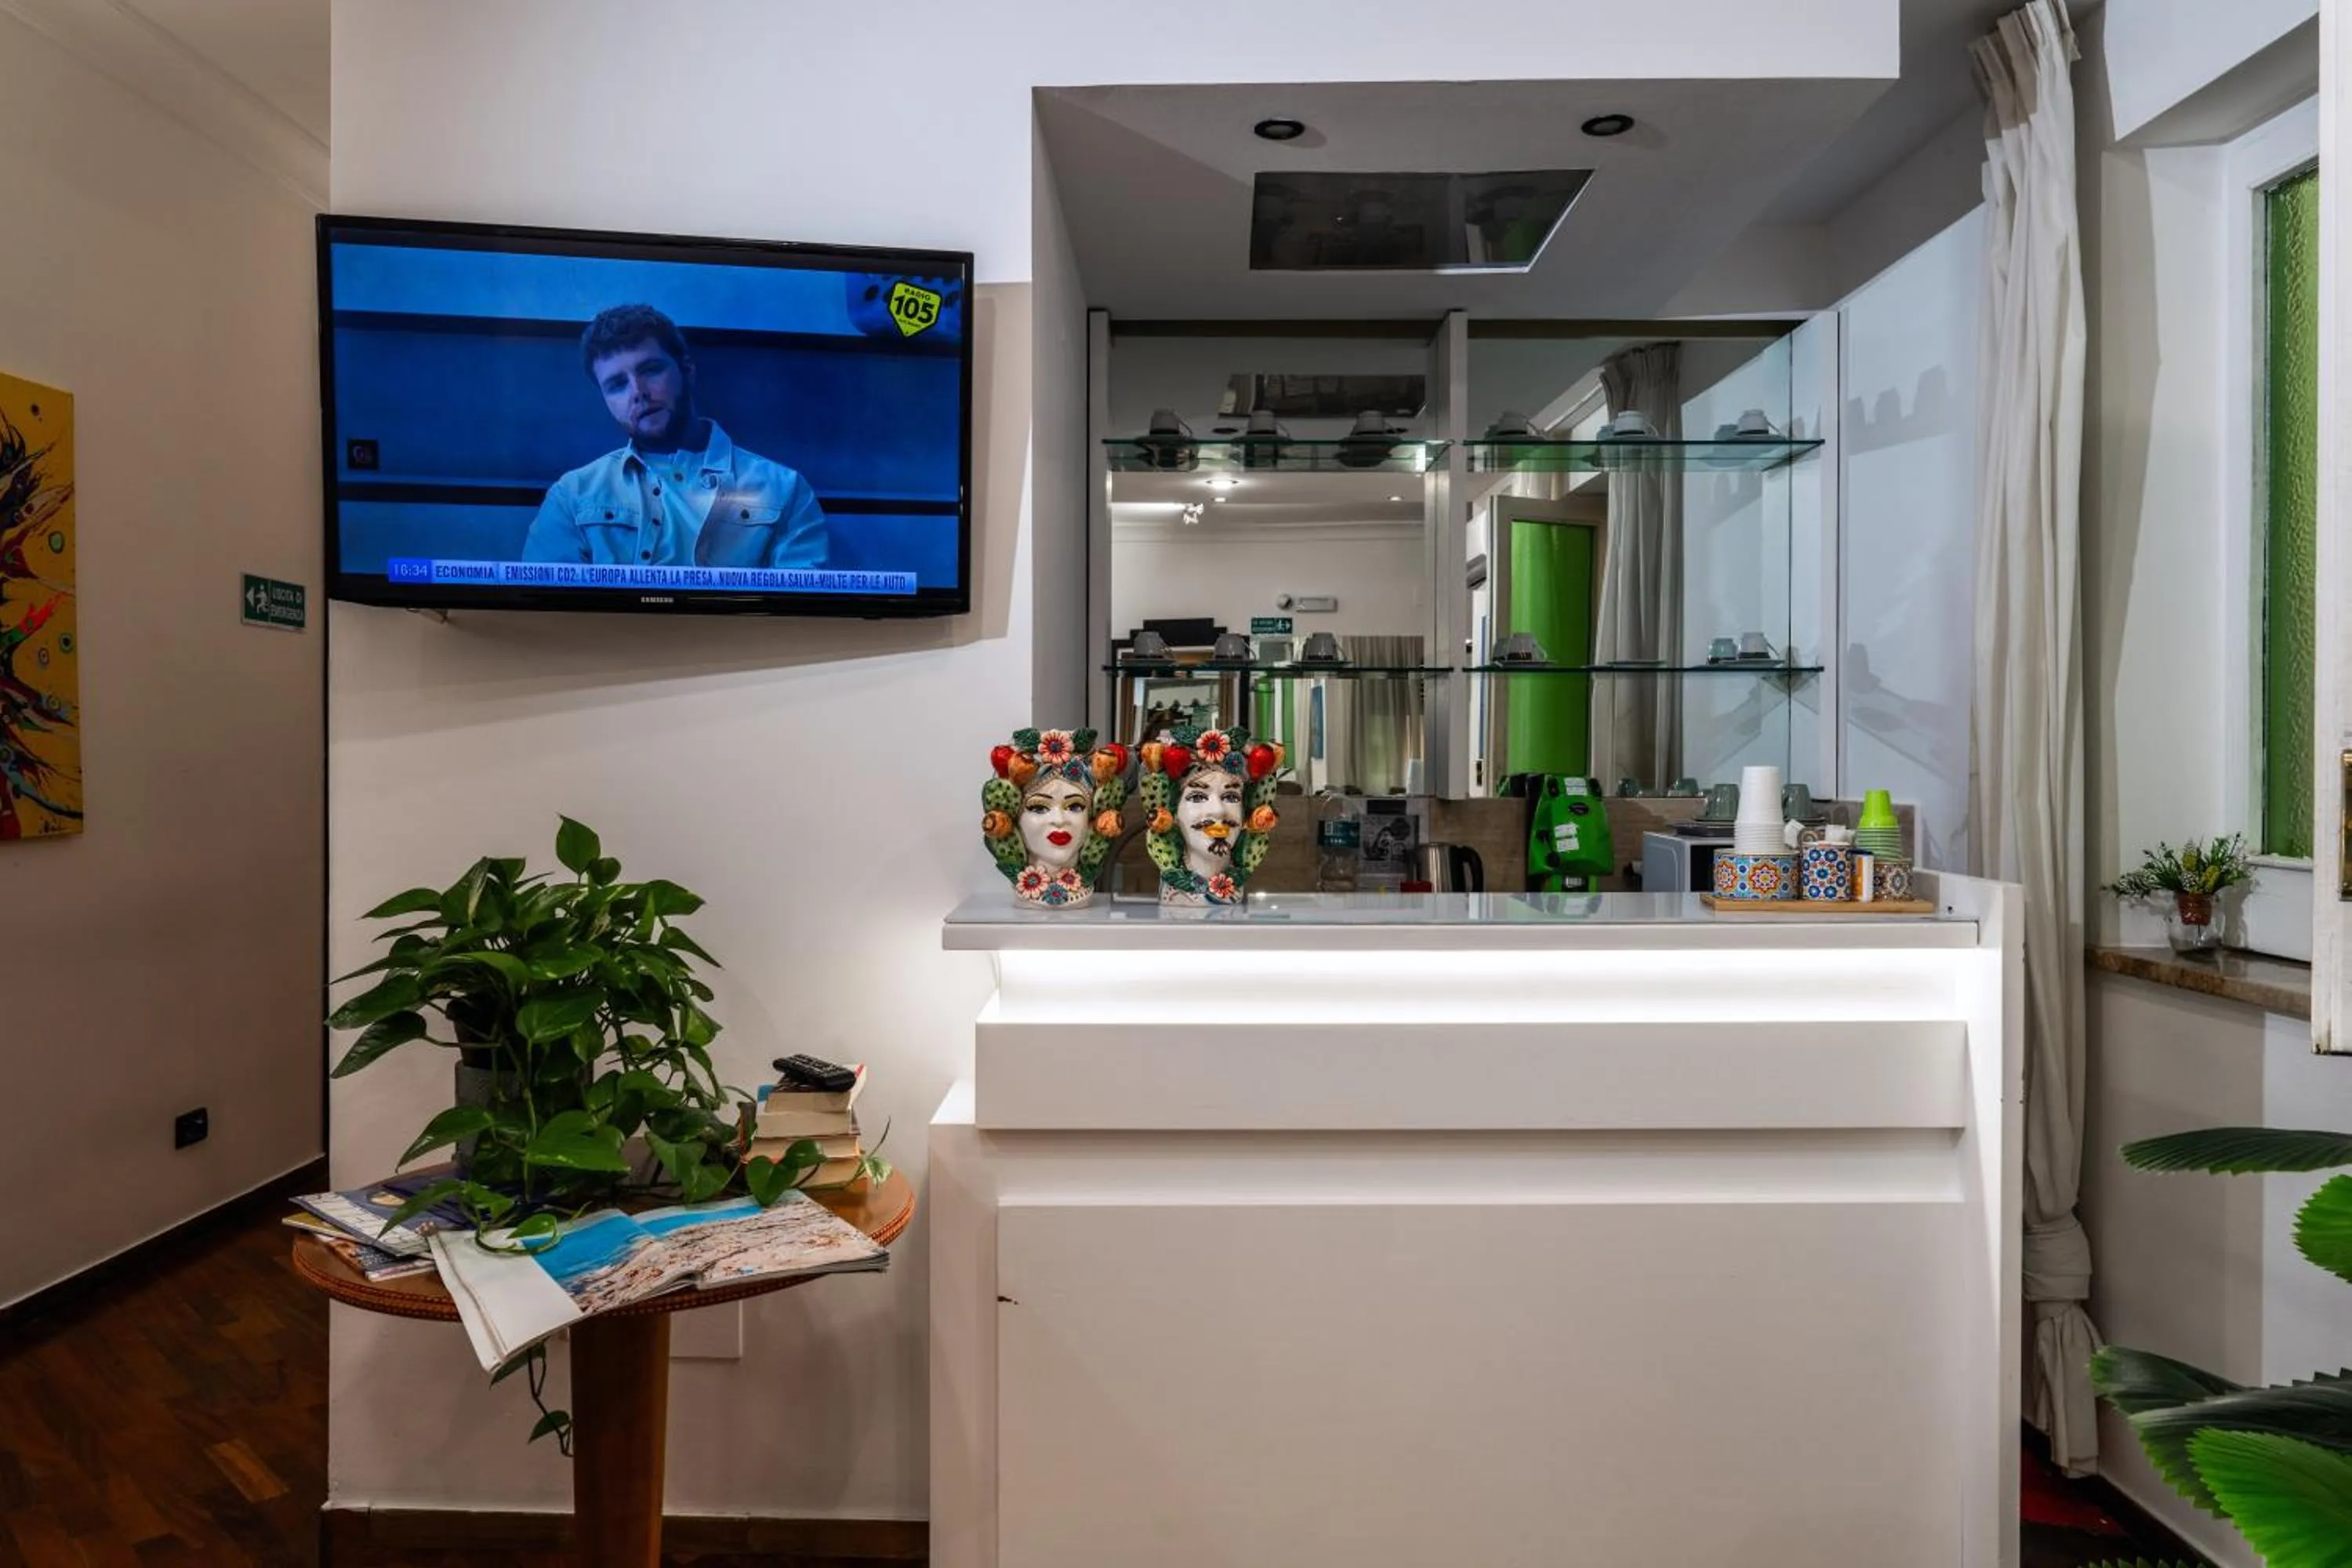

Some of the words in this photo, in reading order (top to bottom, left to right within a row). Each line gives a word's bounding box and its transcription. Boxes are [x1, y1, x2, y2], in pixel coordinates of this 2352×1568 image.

[904, 288, 931, 300] RADIO
[895, 295, 935, 323] 105
[394, 563, 428, 577] 16:34
[435, 564, 495, 579] ECONOMIA
[505, 565, 555, 581] EMISSIONI
[581, 567, 626, 584] L'EUROPA
[630, 568, 666, 585] ALLENTA
[671, 570, 681, 585] LA
[719, 571, 747, 587] NUOVA
[750, 572, 785, 588] REGOLA
[788, 572, 847, 590] SALVA-MULTE
[849, 575, 867, 590] PER
[869, 575, 882, 590] LE
[883, 575, 906, 590] AUTO
